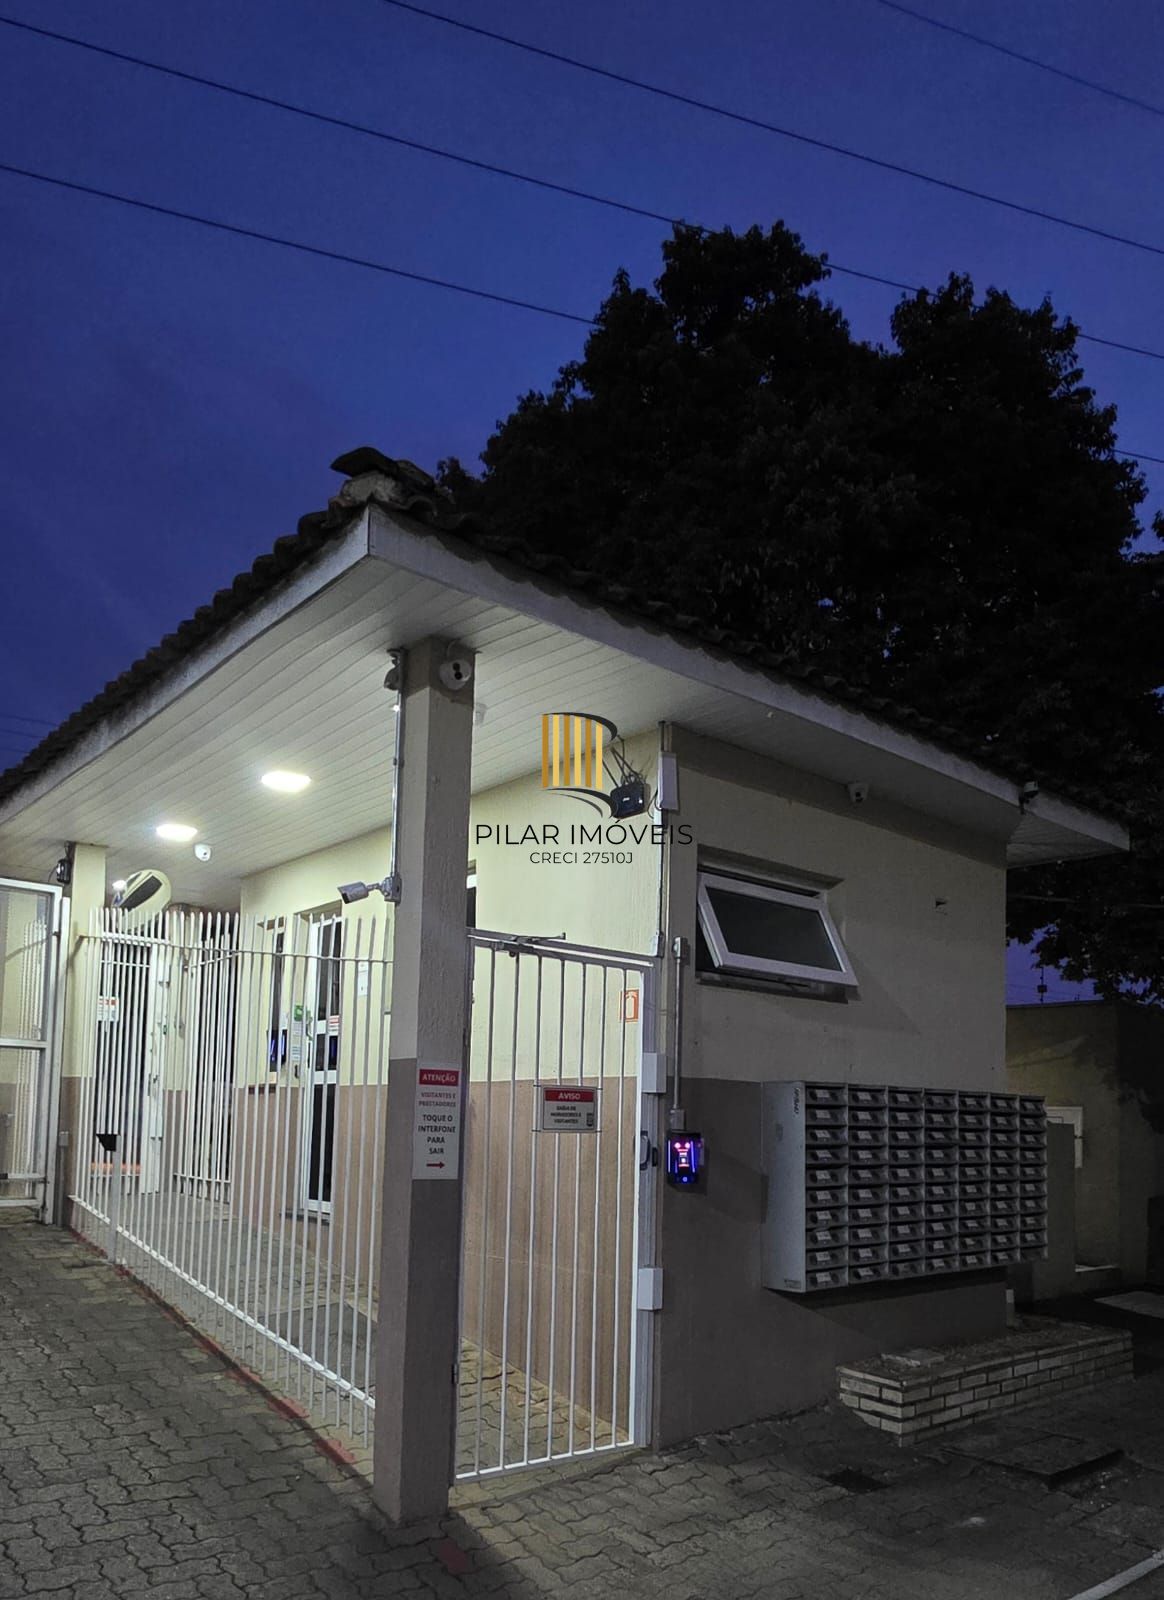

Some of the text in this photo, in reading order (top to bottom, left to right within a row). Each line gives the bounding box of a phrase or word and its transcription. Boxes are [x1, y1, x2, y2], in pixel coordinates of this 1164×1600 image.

[422, 1072, 456, 1083] ATENÇÃO
[558, 1092, 581, 1100] AVISO
[422, 1114, 453, 1122] TOQUE O
[418, 1125, 456, 1133] INTERFONE
[429, 1147, 445, 1155] SAIR
